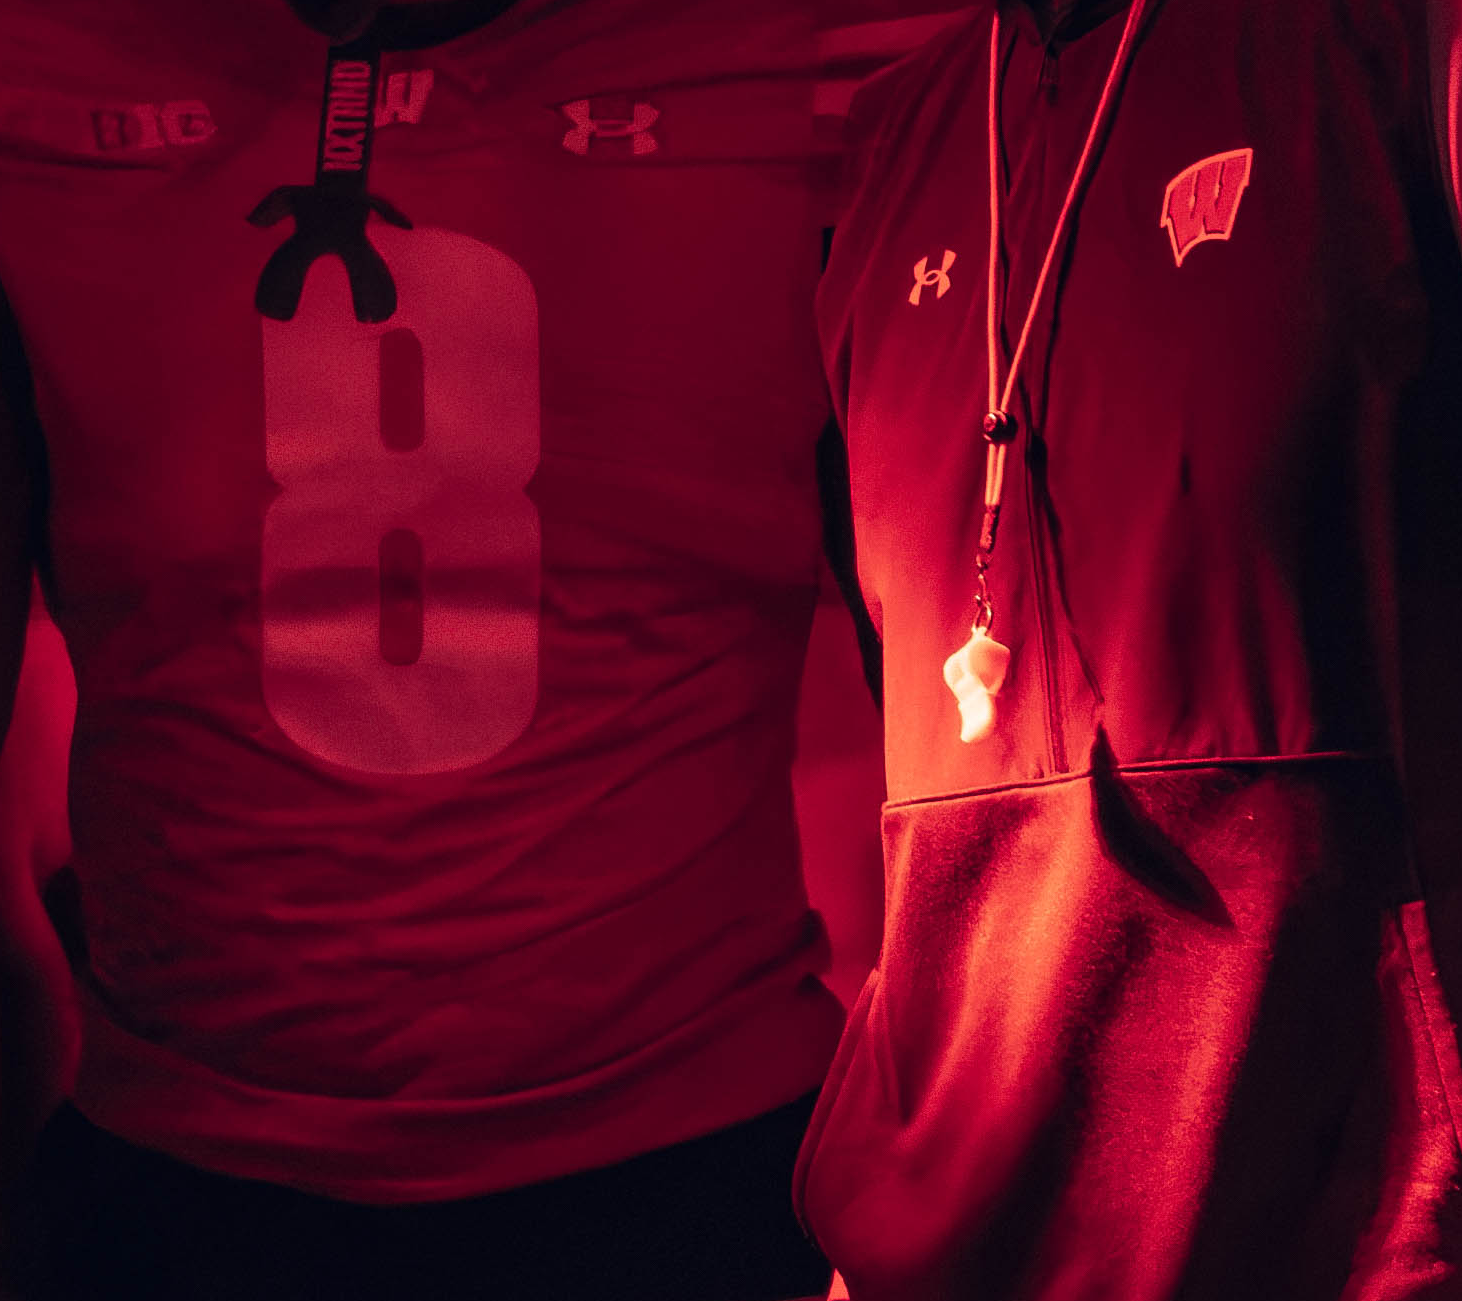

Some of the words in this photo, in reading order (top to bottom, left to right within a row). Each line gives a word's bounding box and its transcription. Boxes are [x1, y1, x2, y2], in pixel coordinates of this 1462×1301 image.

[322, 59, 372, 172] NXTRND
[1158, 146, 1255, 268] W
[259, 227, 543, 776] 8
